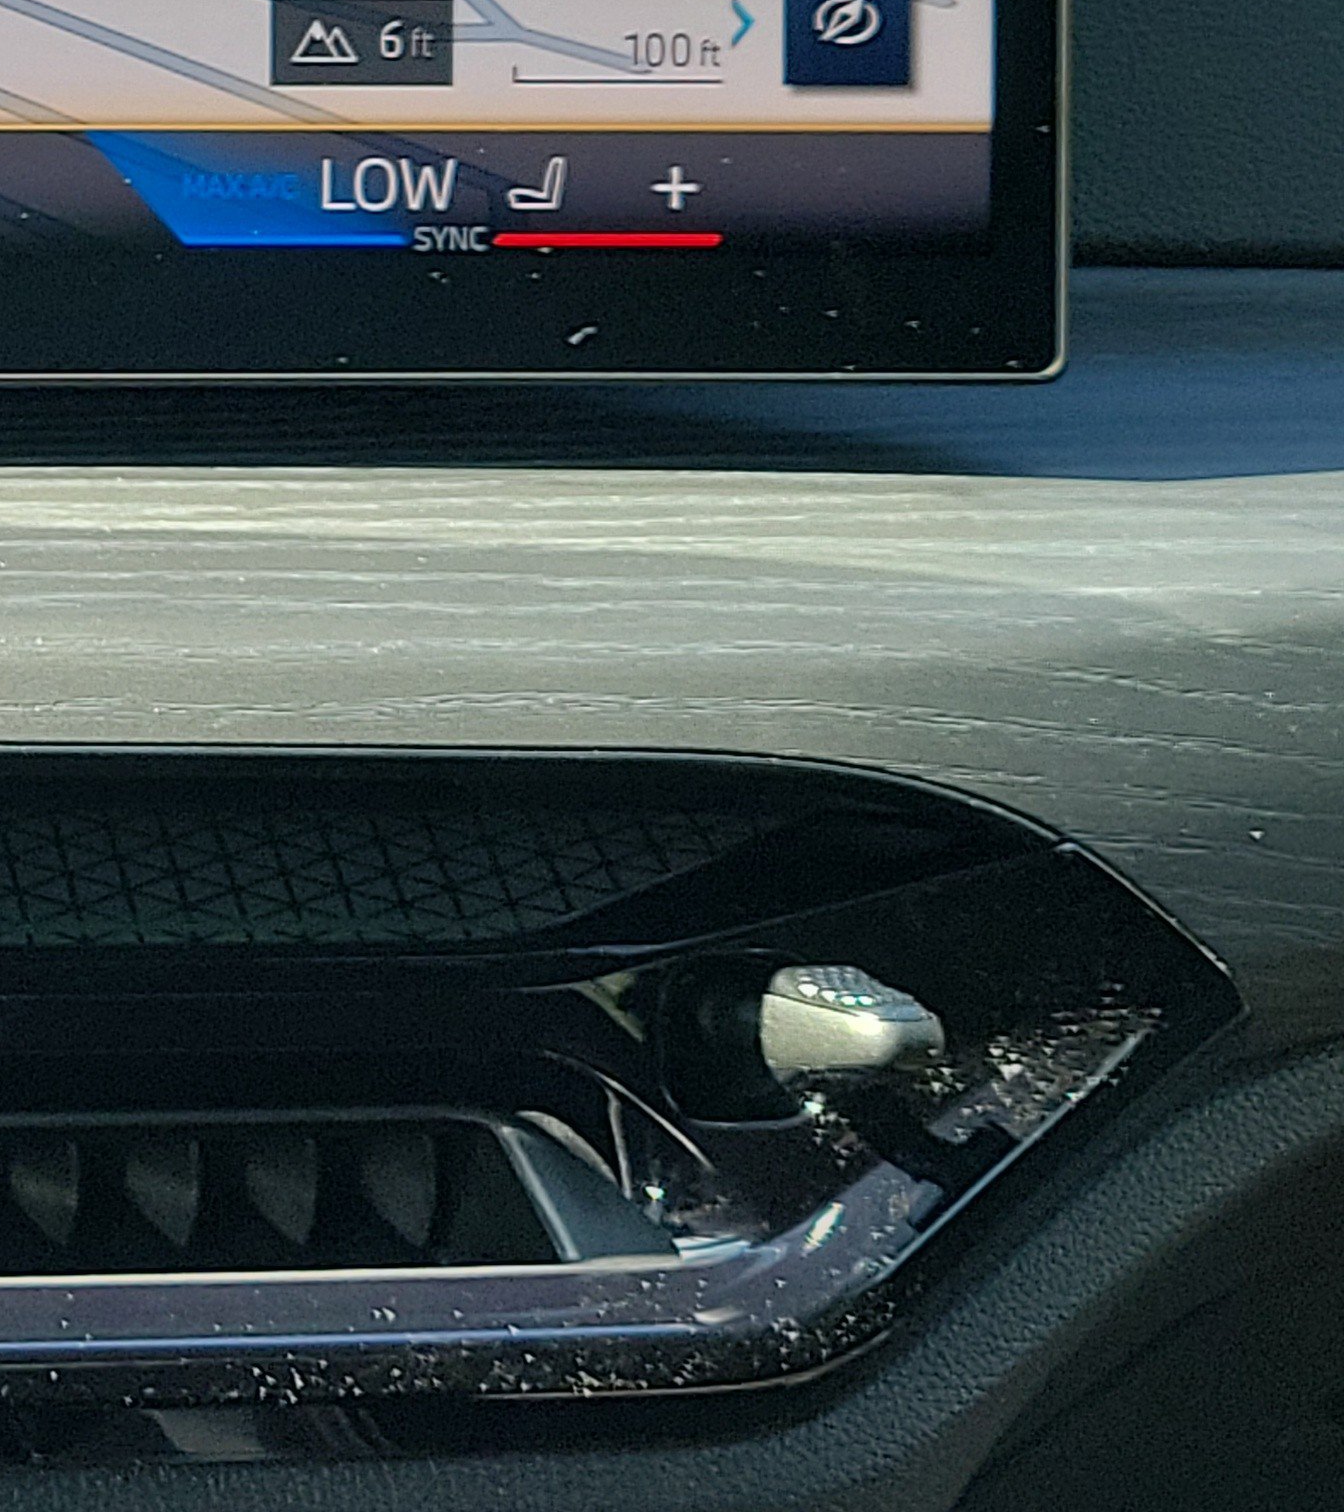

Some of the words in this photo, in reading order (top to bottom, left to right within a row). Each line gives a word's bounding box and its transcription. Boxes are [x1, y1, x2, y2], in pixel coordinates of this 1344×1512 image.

[379, 20, 404, 59] 6
[412, 27, 434, 58] ft
[624, 33, 692, 67] 100
[699, 40, 721, 67] ft
[321, 157, 458, 212] LOW
[413, 226, 490, 252] SYNC
